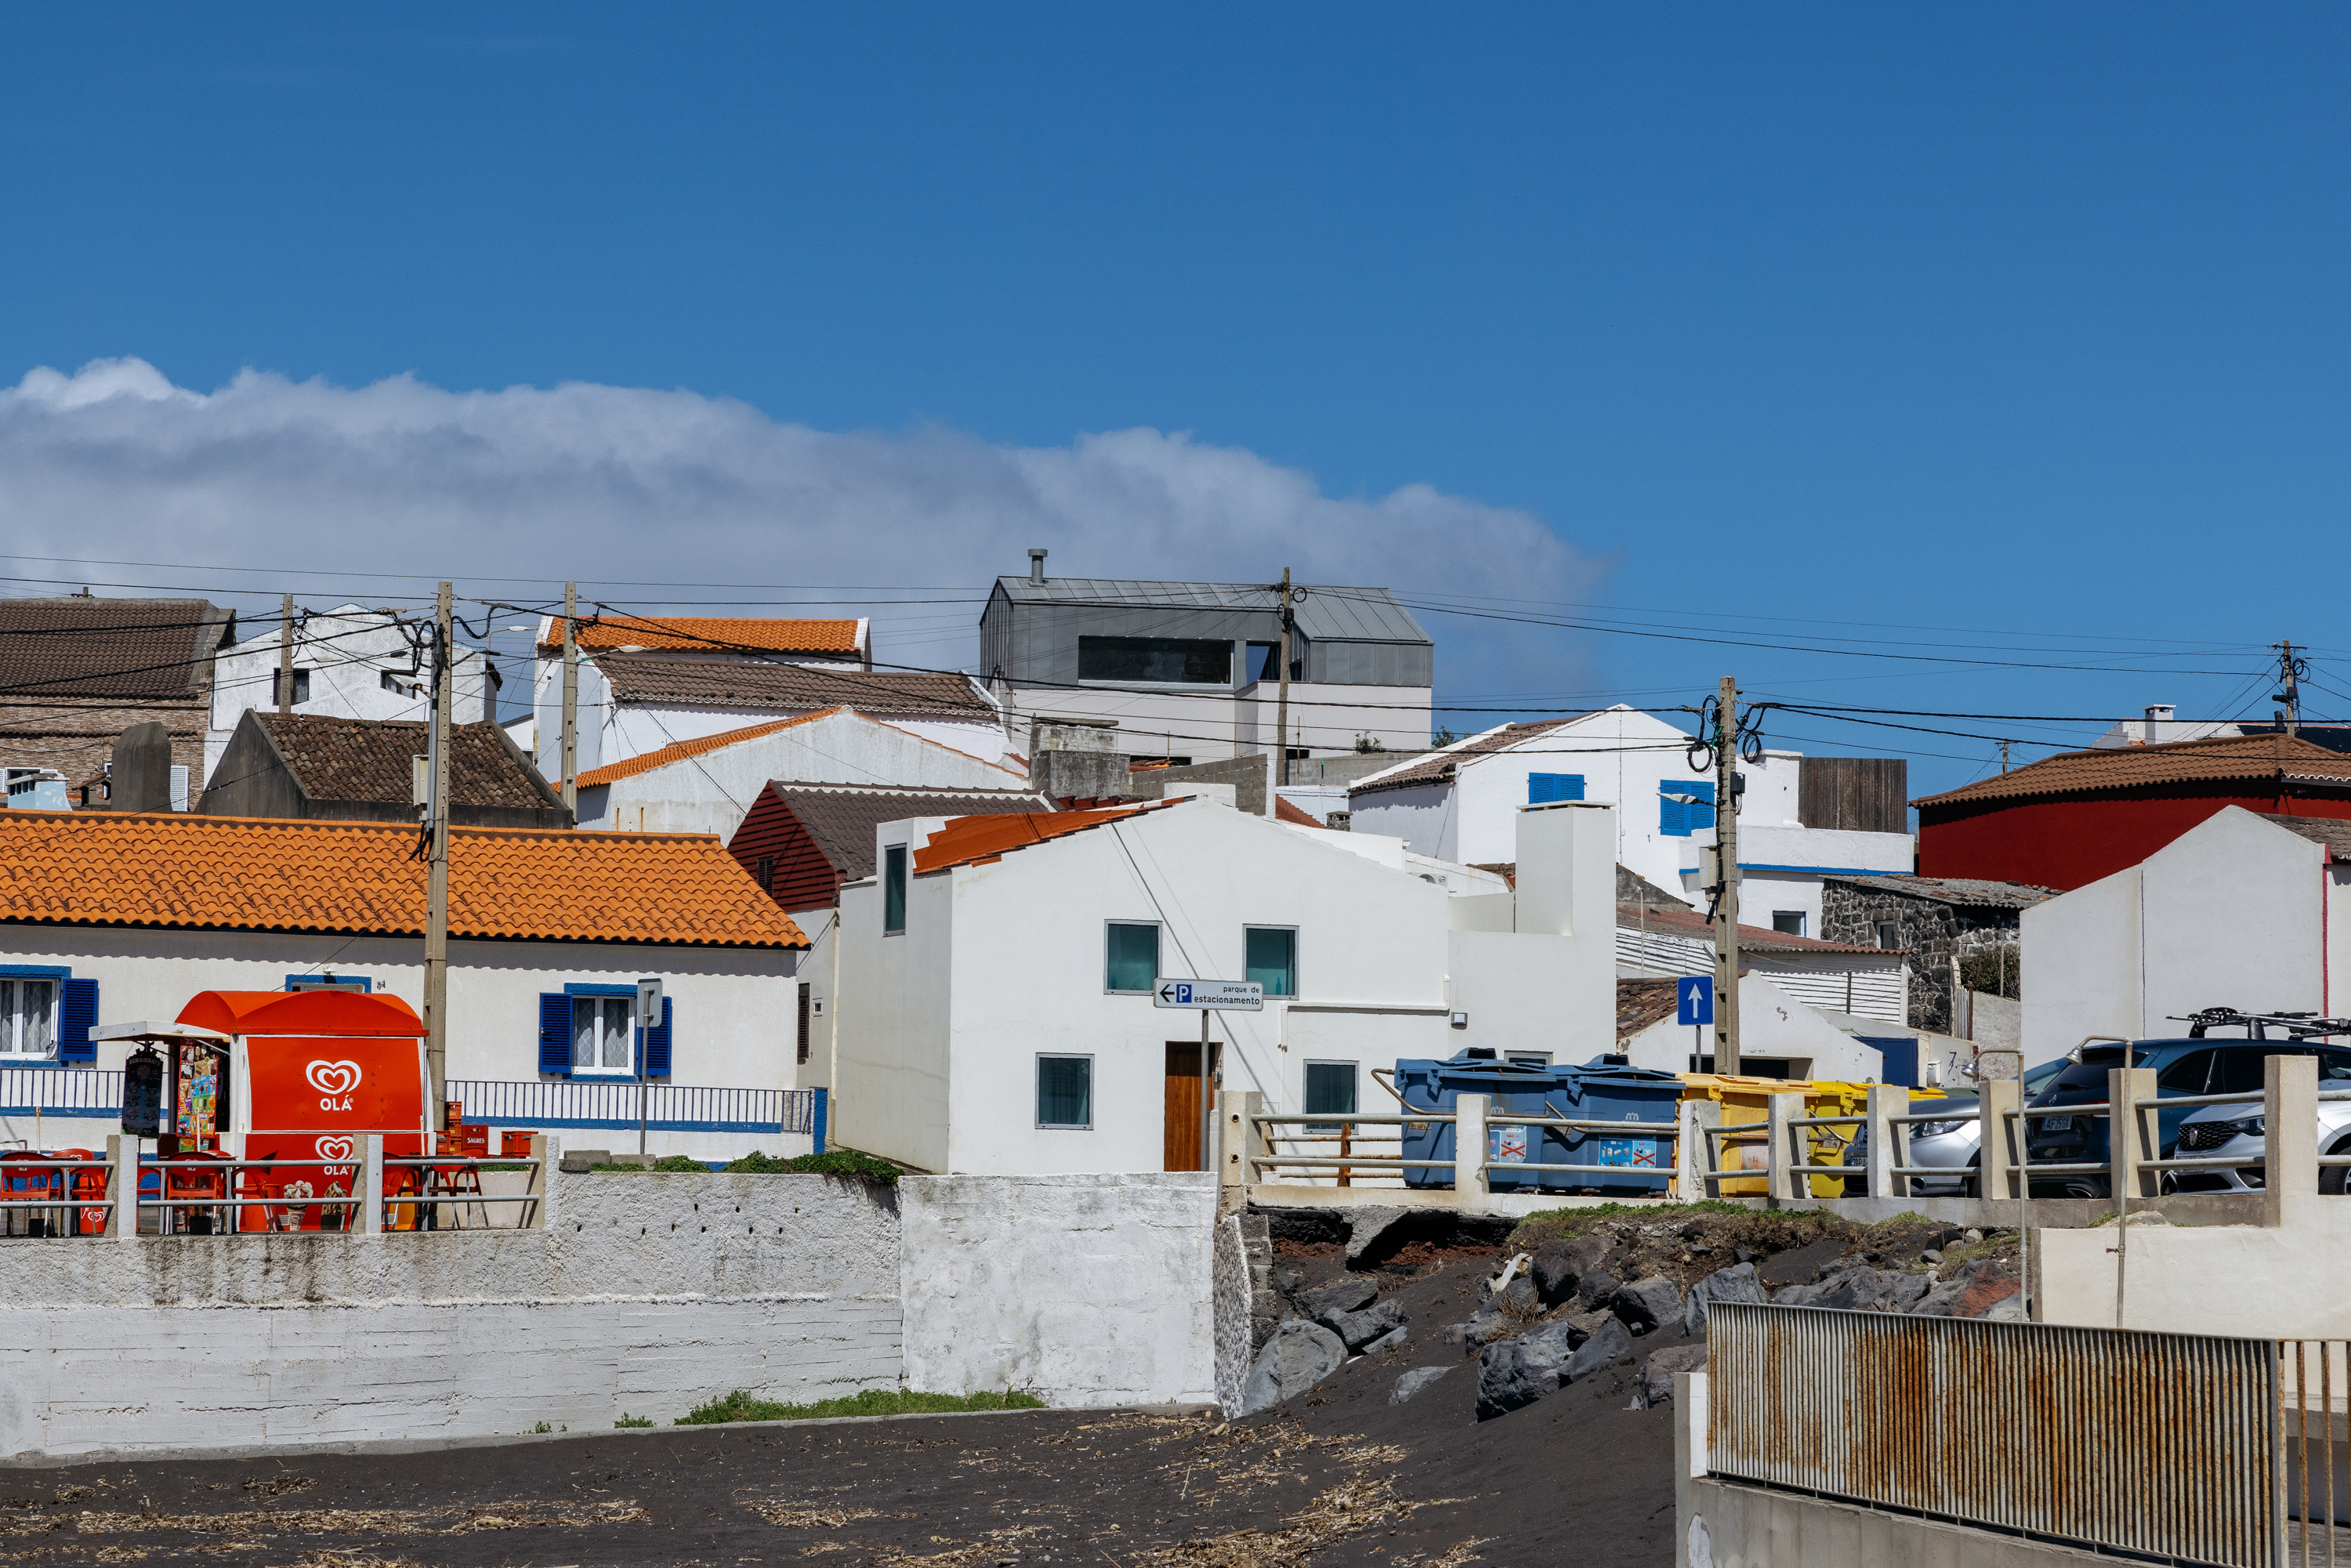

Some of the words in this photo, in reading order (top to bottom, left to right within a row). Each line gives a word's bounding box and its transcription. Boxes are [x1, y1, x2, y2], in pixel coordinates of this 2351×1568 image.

[1179, 985, 1189, 1002] P
[1194, 995, 1260, 1005] estacionamento
[320, 1094, 353, 1111] OLÁ
